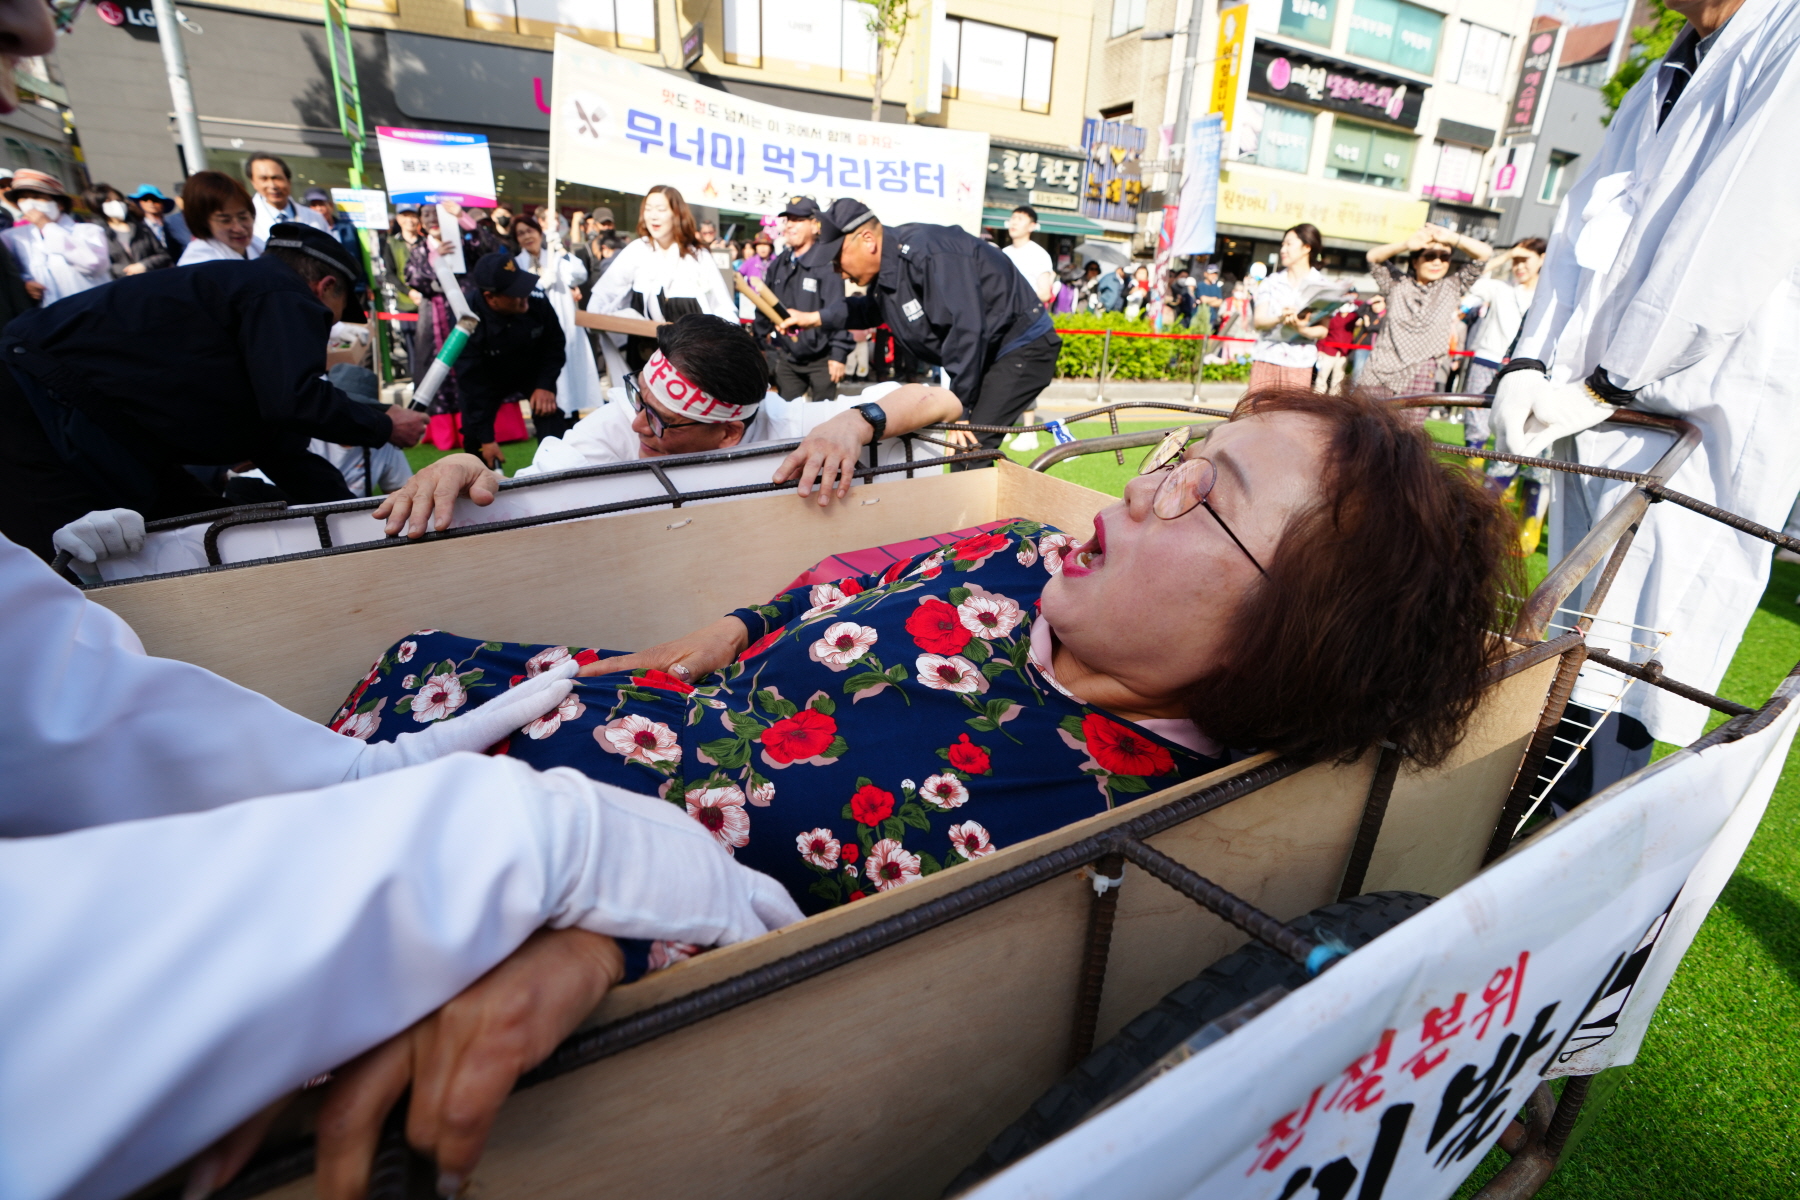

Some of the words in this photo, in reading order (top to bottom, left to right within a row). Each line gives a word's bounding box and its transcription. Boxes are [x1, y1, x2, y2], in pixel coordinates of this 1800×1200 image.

[125, 6, 158, 28] LG
[662, 89, 689, 110] 맛도
[694, 98, 719, 118] 정도
[724, 107, 762, 129] 넘치는
[768, 120, 780, 133] 이
[828, 130, 852, 144] 함께
[625, 108, 745, 175] 무너미
[762, 143, 945, 198] 먹거리장터
